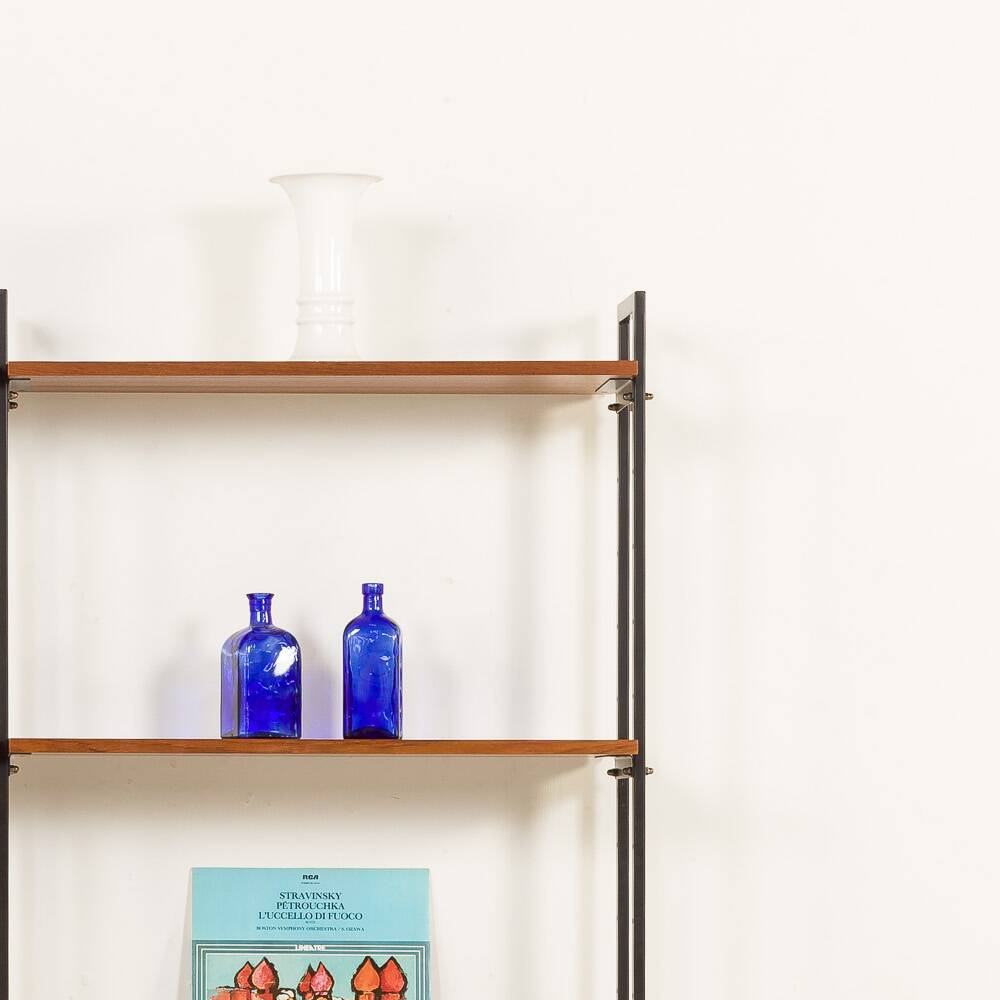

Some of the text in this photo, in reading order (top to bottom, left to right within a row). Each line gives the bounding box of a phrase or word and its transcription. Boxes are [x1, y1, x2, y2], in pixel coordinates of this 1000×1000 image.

[279, 892, 341, 900] STRAVINSKY
[258, 911, 363, 921] L'UCCELLO DI FUOCO
